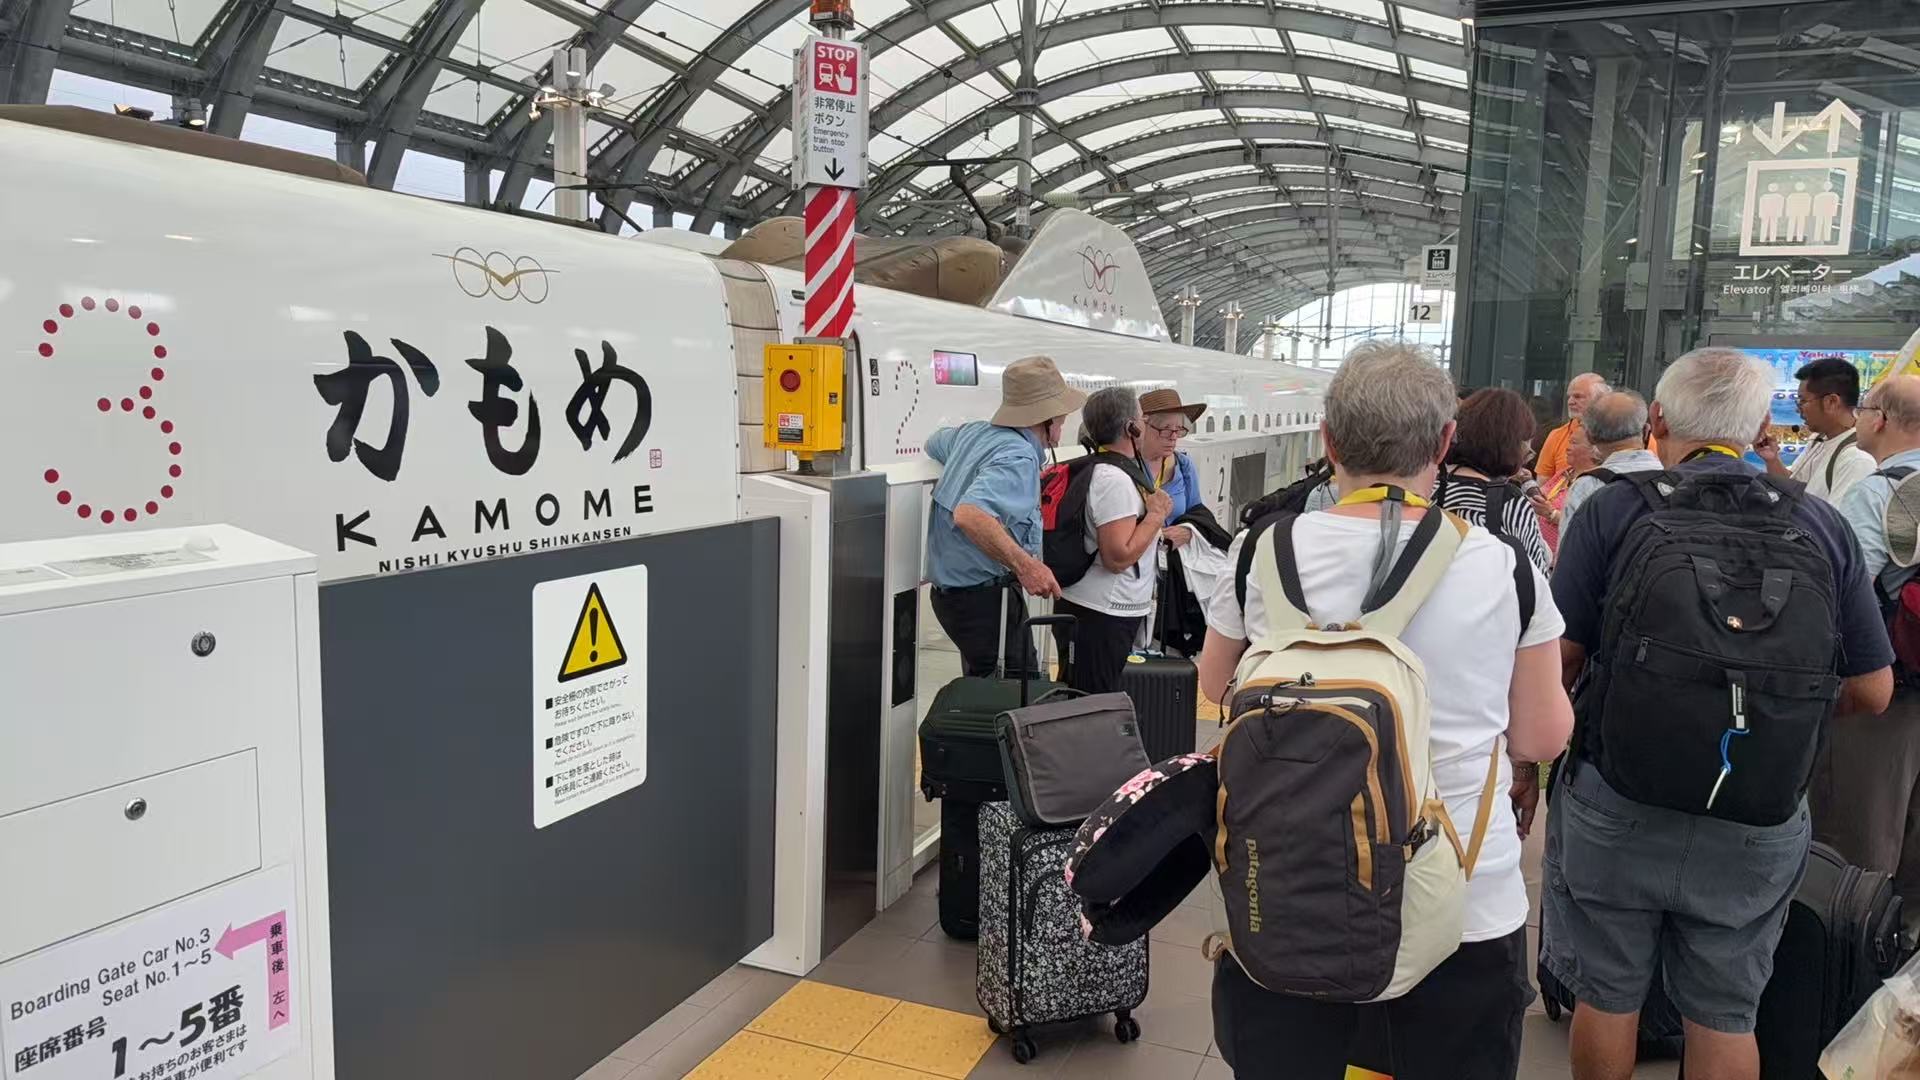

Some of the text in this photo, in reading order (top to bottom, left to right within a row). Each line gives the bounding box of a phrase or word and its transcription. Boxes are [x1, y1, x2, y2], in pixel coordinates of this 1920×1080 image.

[818, 45, 855, 62] STOP
[814, 96, 856, 114] 非常停止
[814, 113, 845, 127] ボタン
[813, 127, 849, 138] Emergency
[813, 136, 846, 147] train stop
[813, 145, 835, 154] button
[1733, 263, 1852, 280] エレベーター
[1723, 284, 1772, 294] Elevator
[1073, 295, 1123, 317] KAMOME
[1411, 304, 1431, 321] 12
[38, 295, 182, 524] 3
[313, 325, 652, 482] かもめ
[895, 360, 920, 455] 2
[336, 484, 653, 552] KAMOME
[379, 526, 632, 574] NISHI KYUSHU SHINKANSEN
[1245, 838, 1262, 933] patagonia
[11, 928, 211, 1020] Boarding Gate Car No.3
[269, 921, 286, 1020] 乗車後 左へ
[103, 984, 140, 1007] Seat
[15, 1015, 107, 1073] 座席番号
[129, 1023, 247, 1080] お持ちのお客さまは
